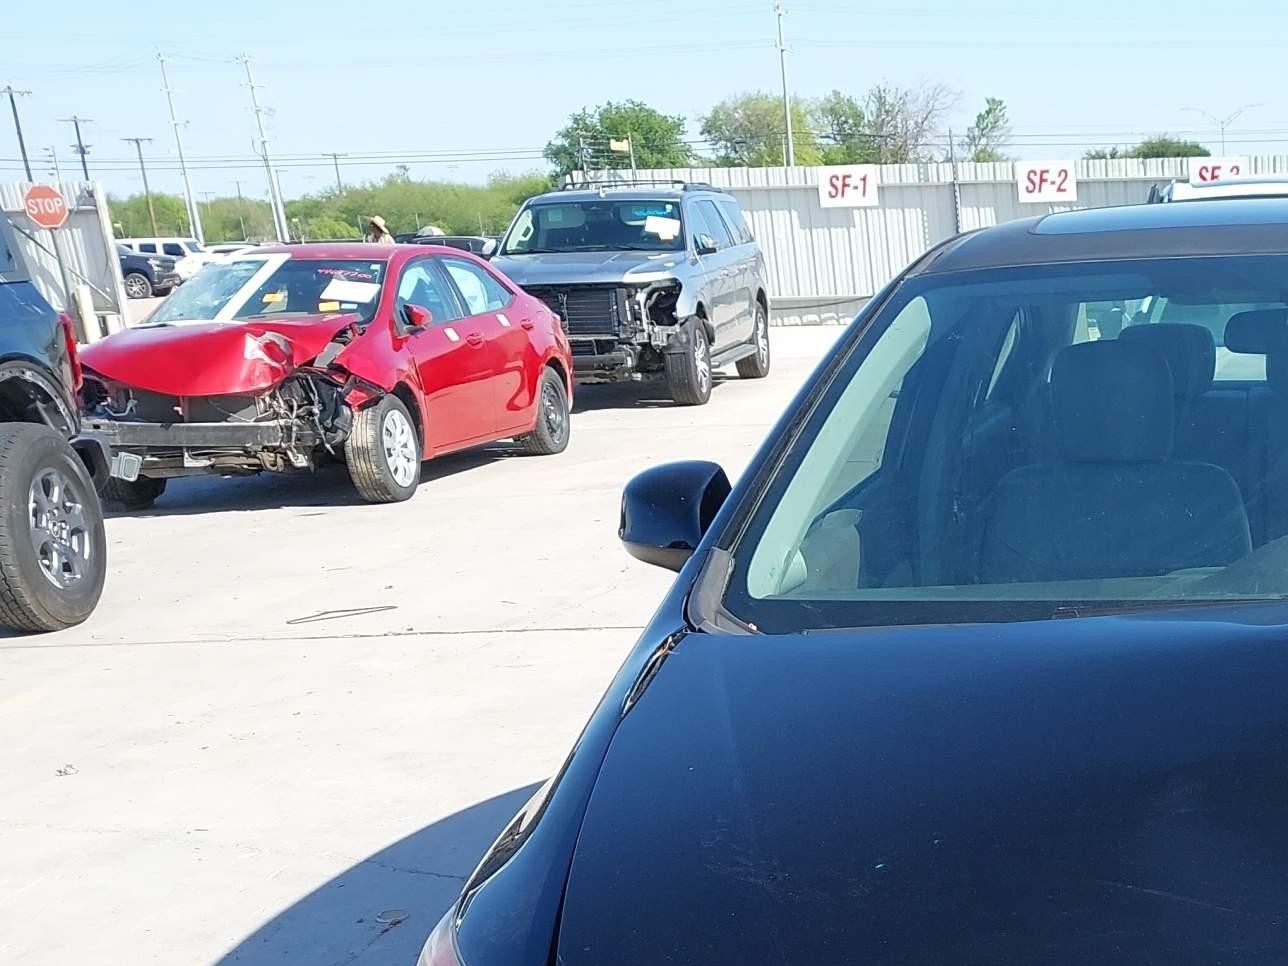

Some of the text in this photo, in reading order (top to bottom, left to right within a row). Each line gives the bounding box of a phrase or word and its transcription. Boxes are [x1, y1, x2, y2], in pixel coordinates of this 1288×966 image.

[1025, 169, 1069, 193] SF-2
[1198, 165, 1241, 181] SF
[828, 174, 868, 198] SF-1
[28, 198, 62, 214] STOP
